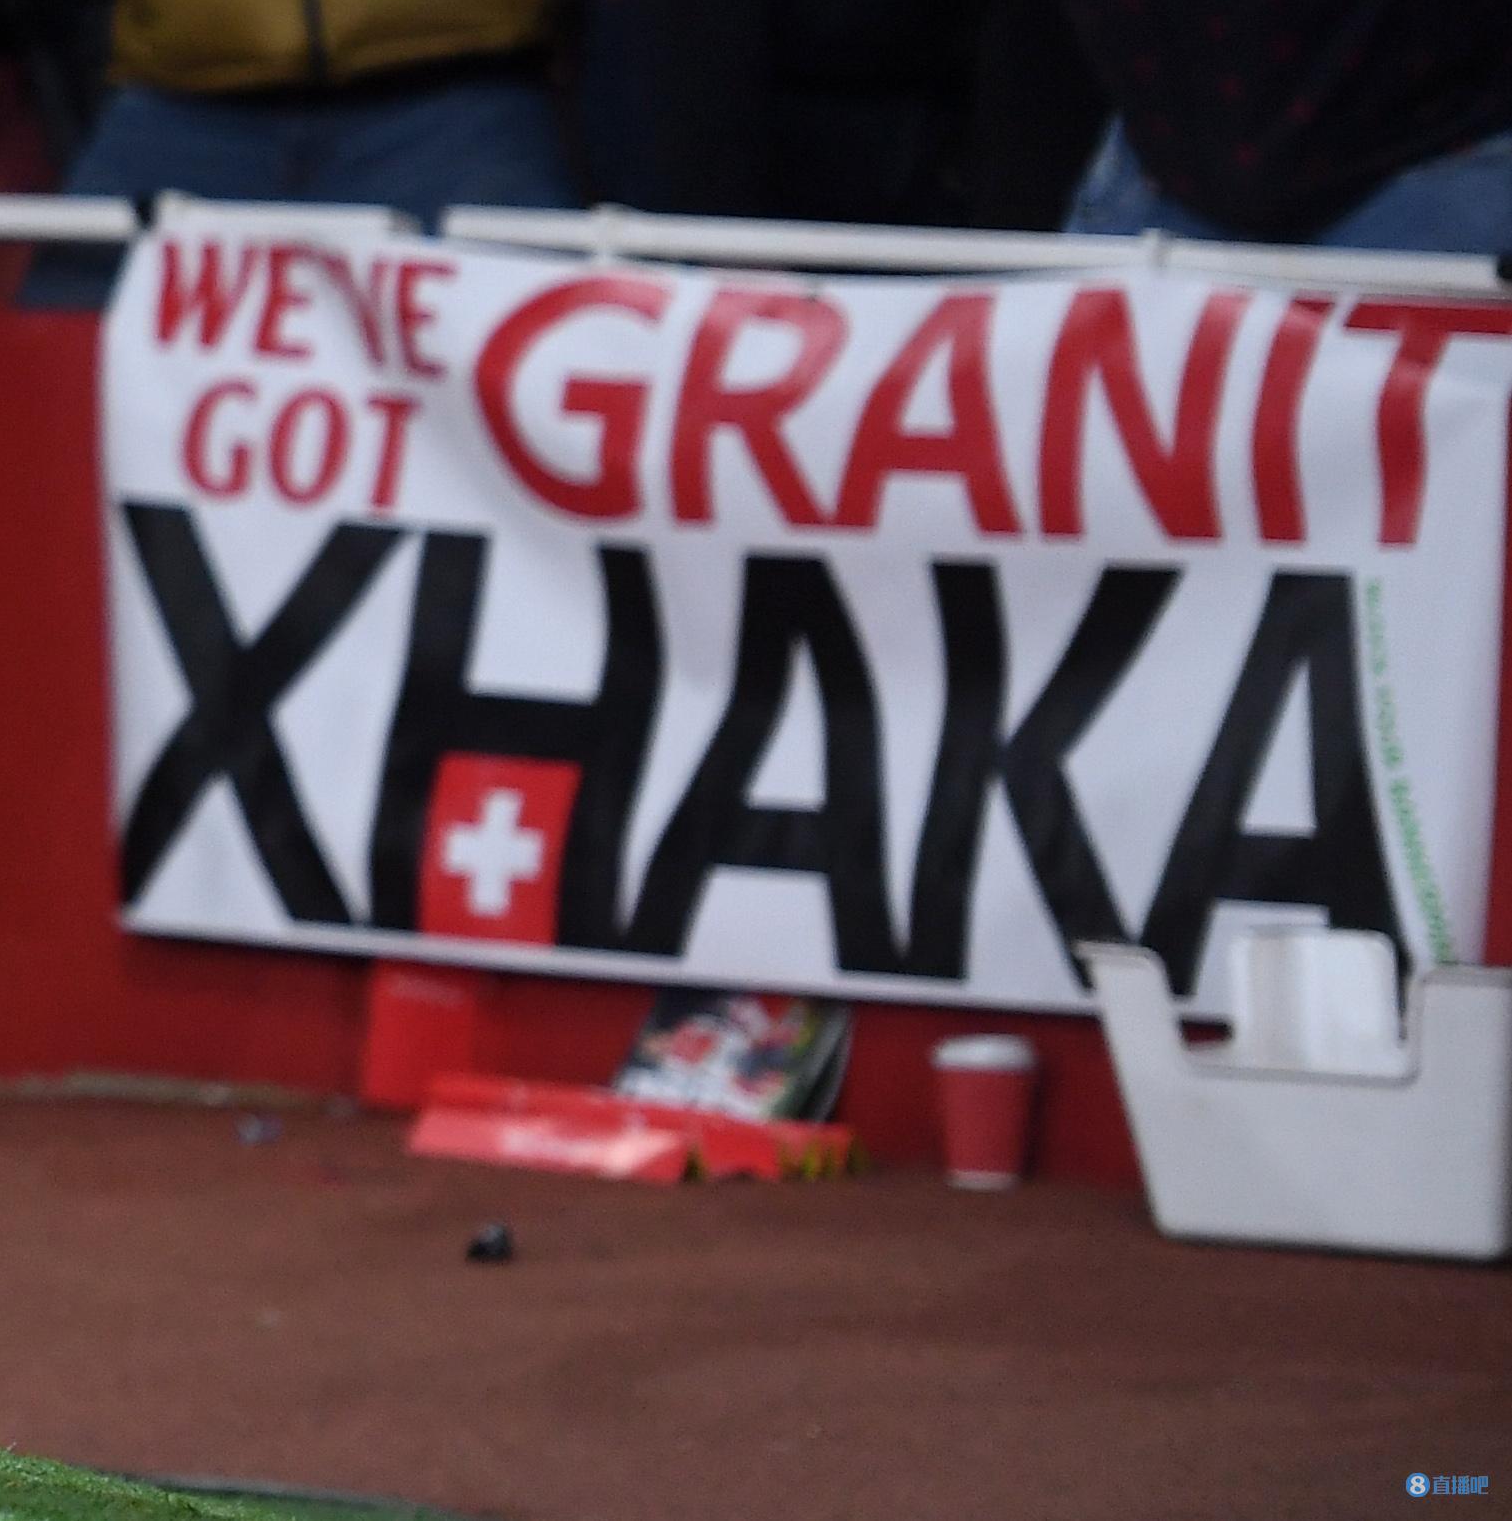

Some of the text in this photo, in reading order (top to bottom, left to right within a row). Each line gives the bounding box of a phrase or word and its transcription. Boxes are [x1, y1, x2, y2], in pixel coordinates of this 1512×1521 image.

[153, 239, 1512, 547] WEVE GRANIT
[181, 376, 421, 515] GOT
[119, 501, 1413, 1039] XHAKA
